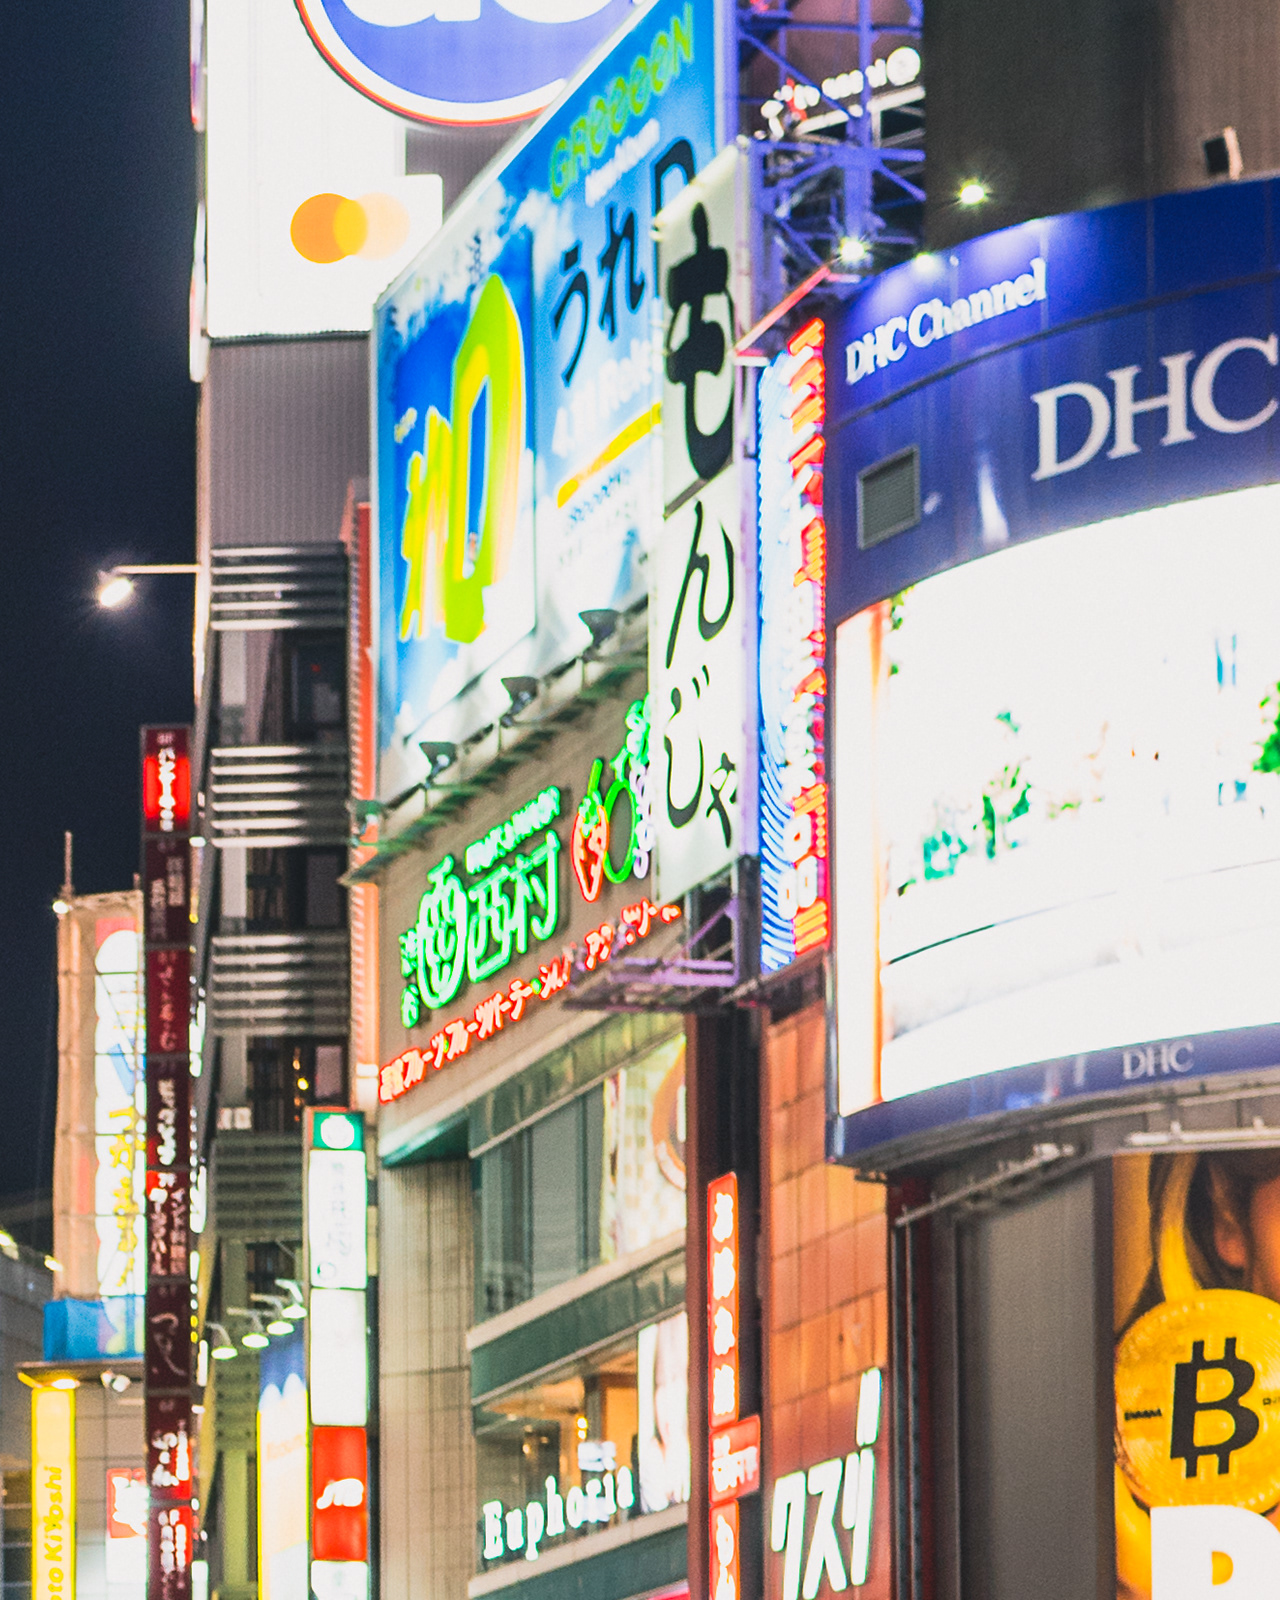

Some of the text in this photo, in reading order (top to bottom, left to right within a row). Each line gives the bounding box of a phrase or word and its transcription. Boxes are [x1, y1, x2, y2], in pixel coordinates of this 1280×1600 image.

[846, 257, 1048, 385] DHC Channel
[1031, 334, 1280, 482] DHC
[664, 201, 737, 848] もんじゃ
[1123, 1041, 1195, 1080] DHC
[483, 1465, 635, 1561] Euphoria
